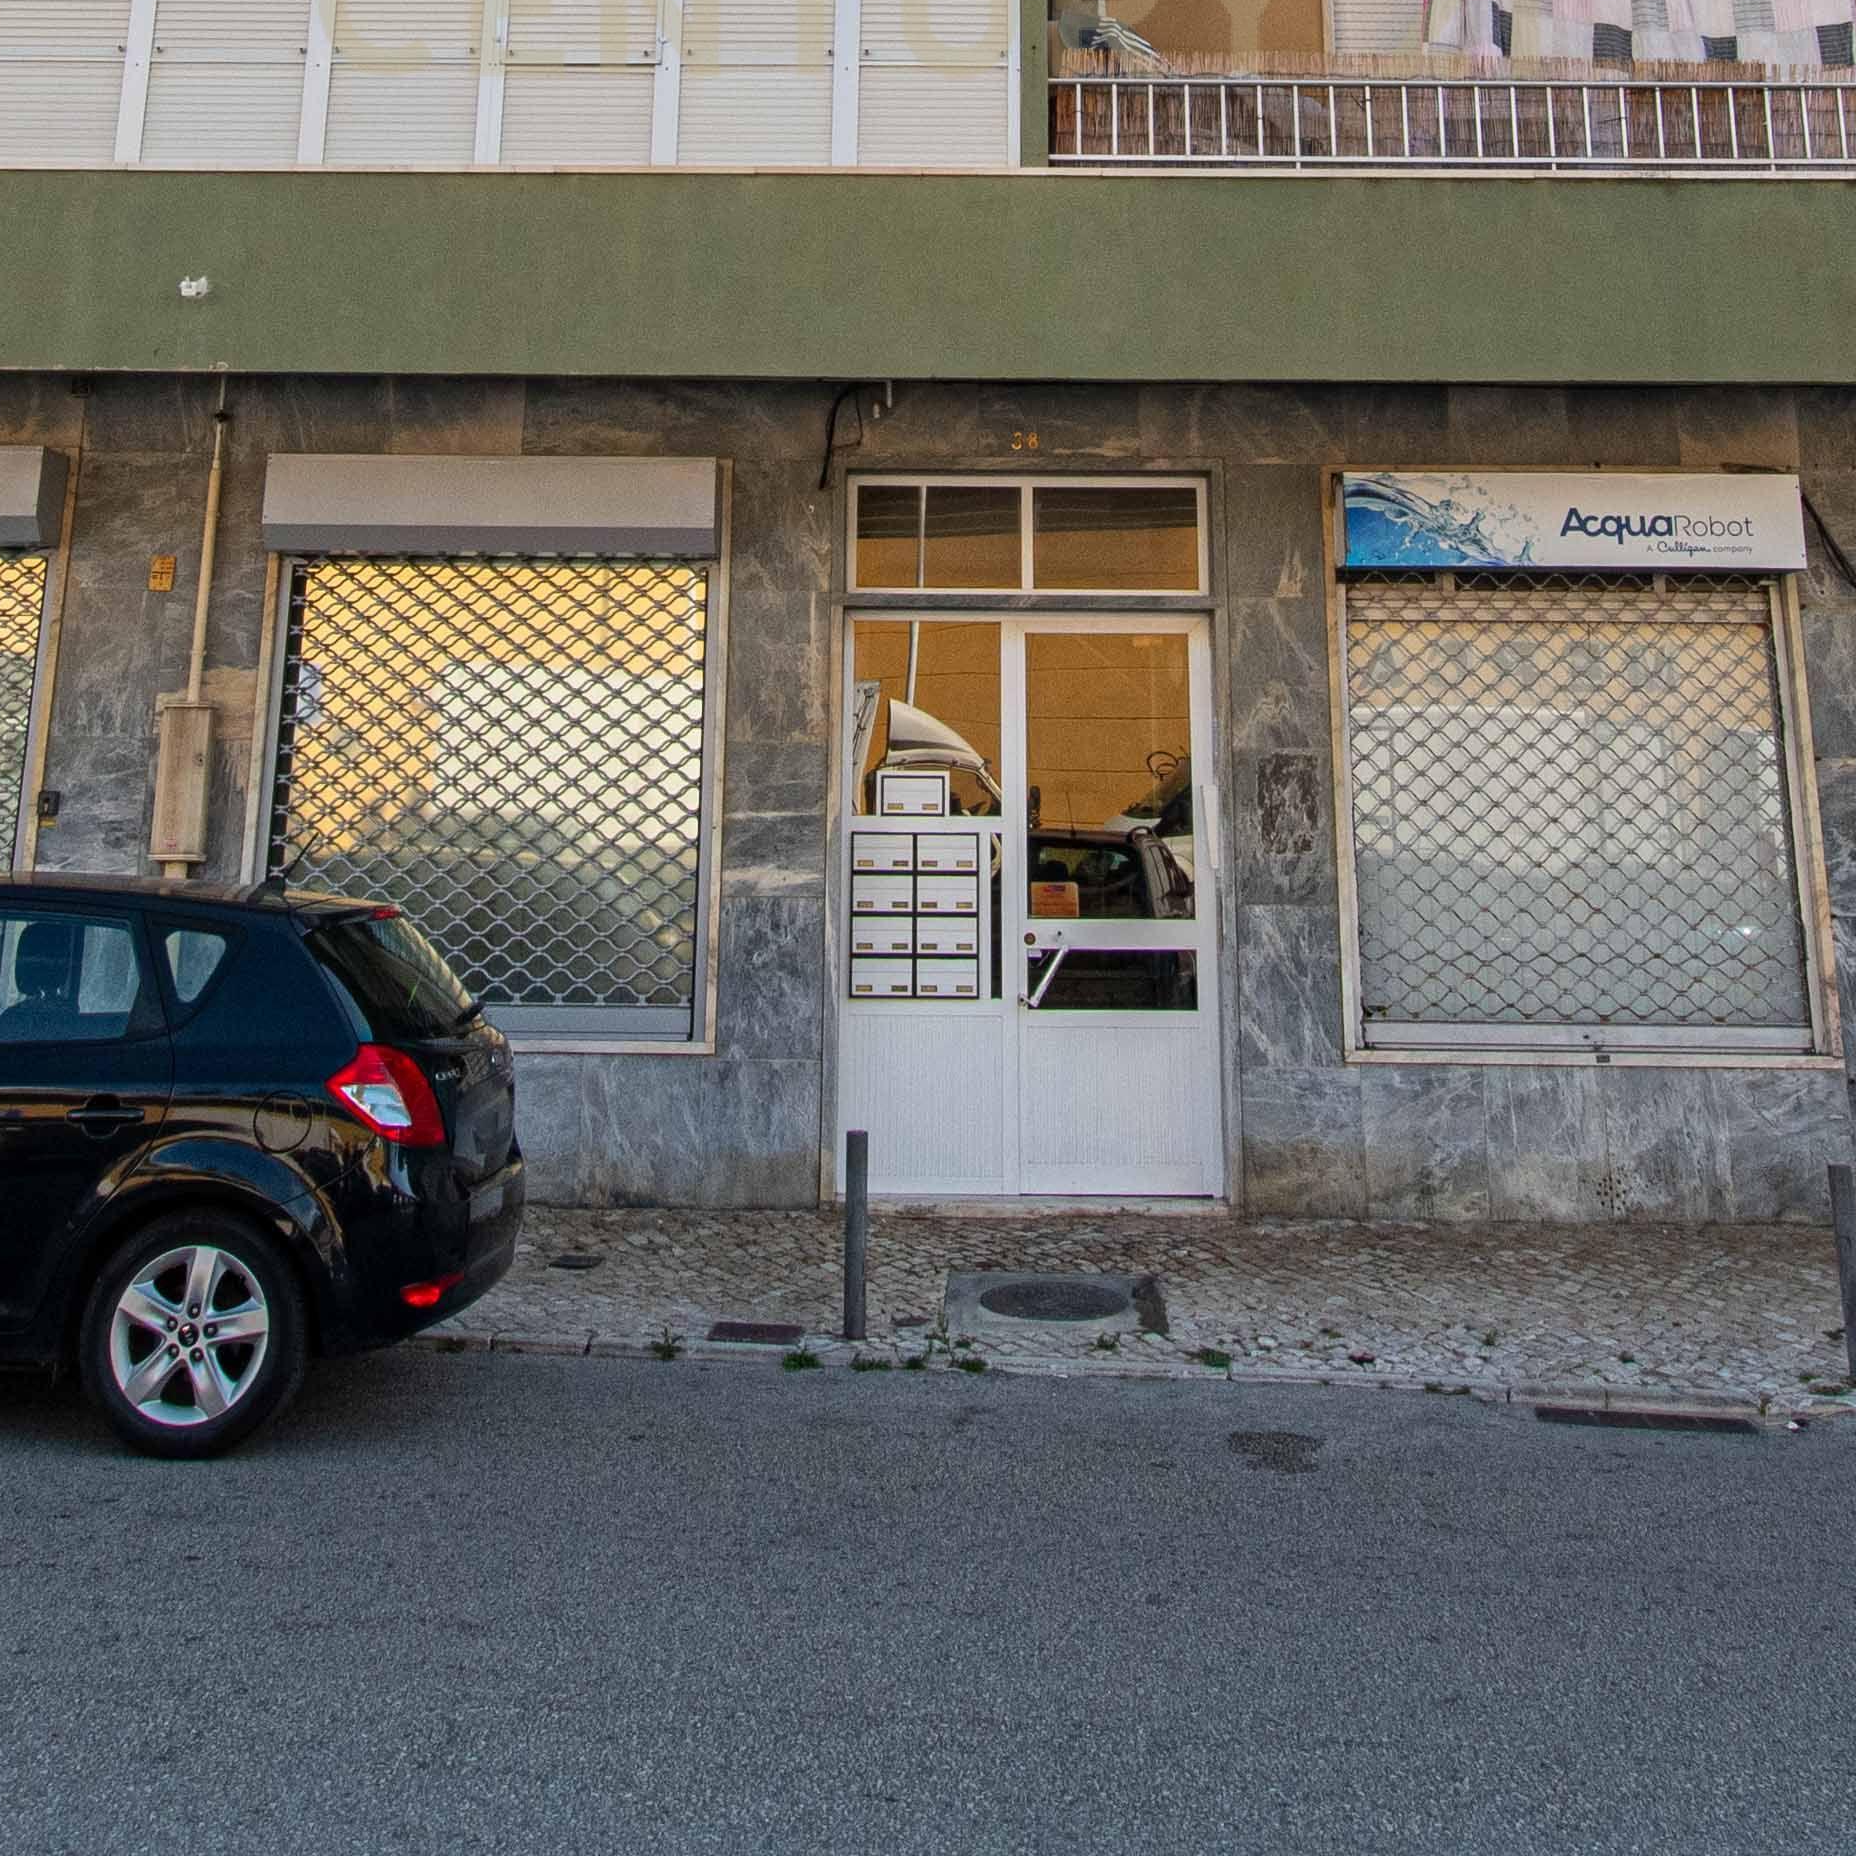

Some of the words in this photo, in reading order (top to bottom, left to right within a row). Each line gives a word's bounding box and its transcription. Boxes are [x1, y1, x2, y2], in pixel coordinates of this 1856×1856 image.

[1010, 431, 1038, 450] 38
[1560, 507, 1754, 545] AcquaRobot
[1657, 540, 1712, 558] Culligan
[1713, 545, 1753, 554] company
